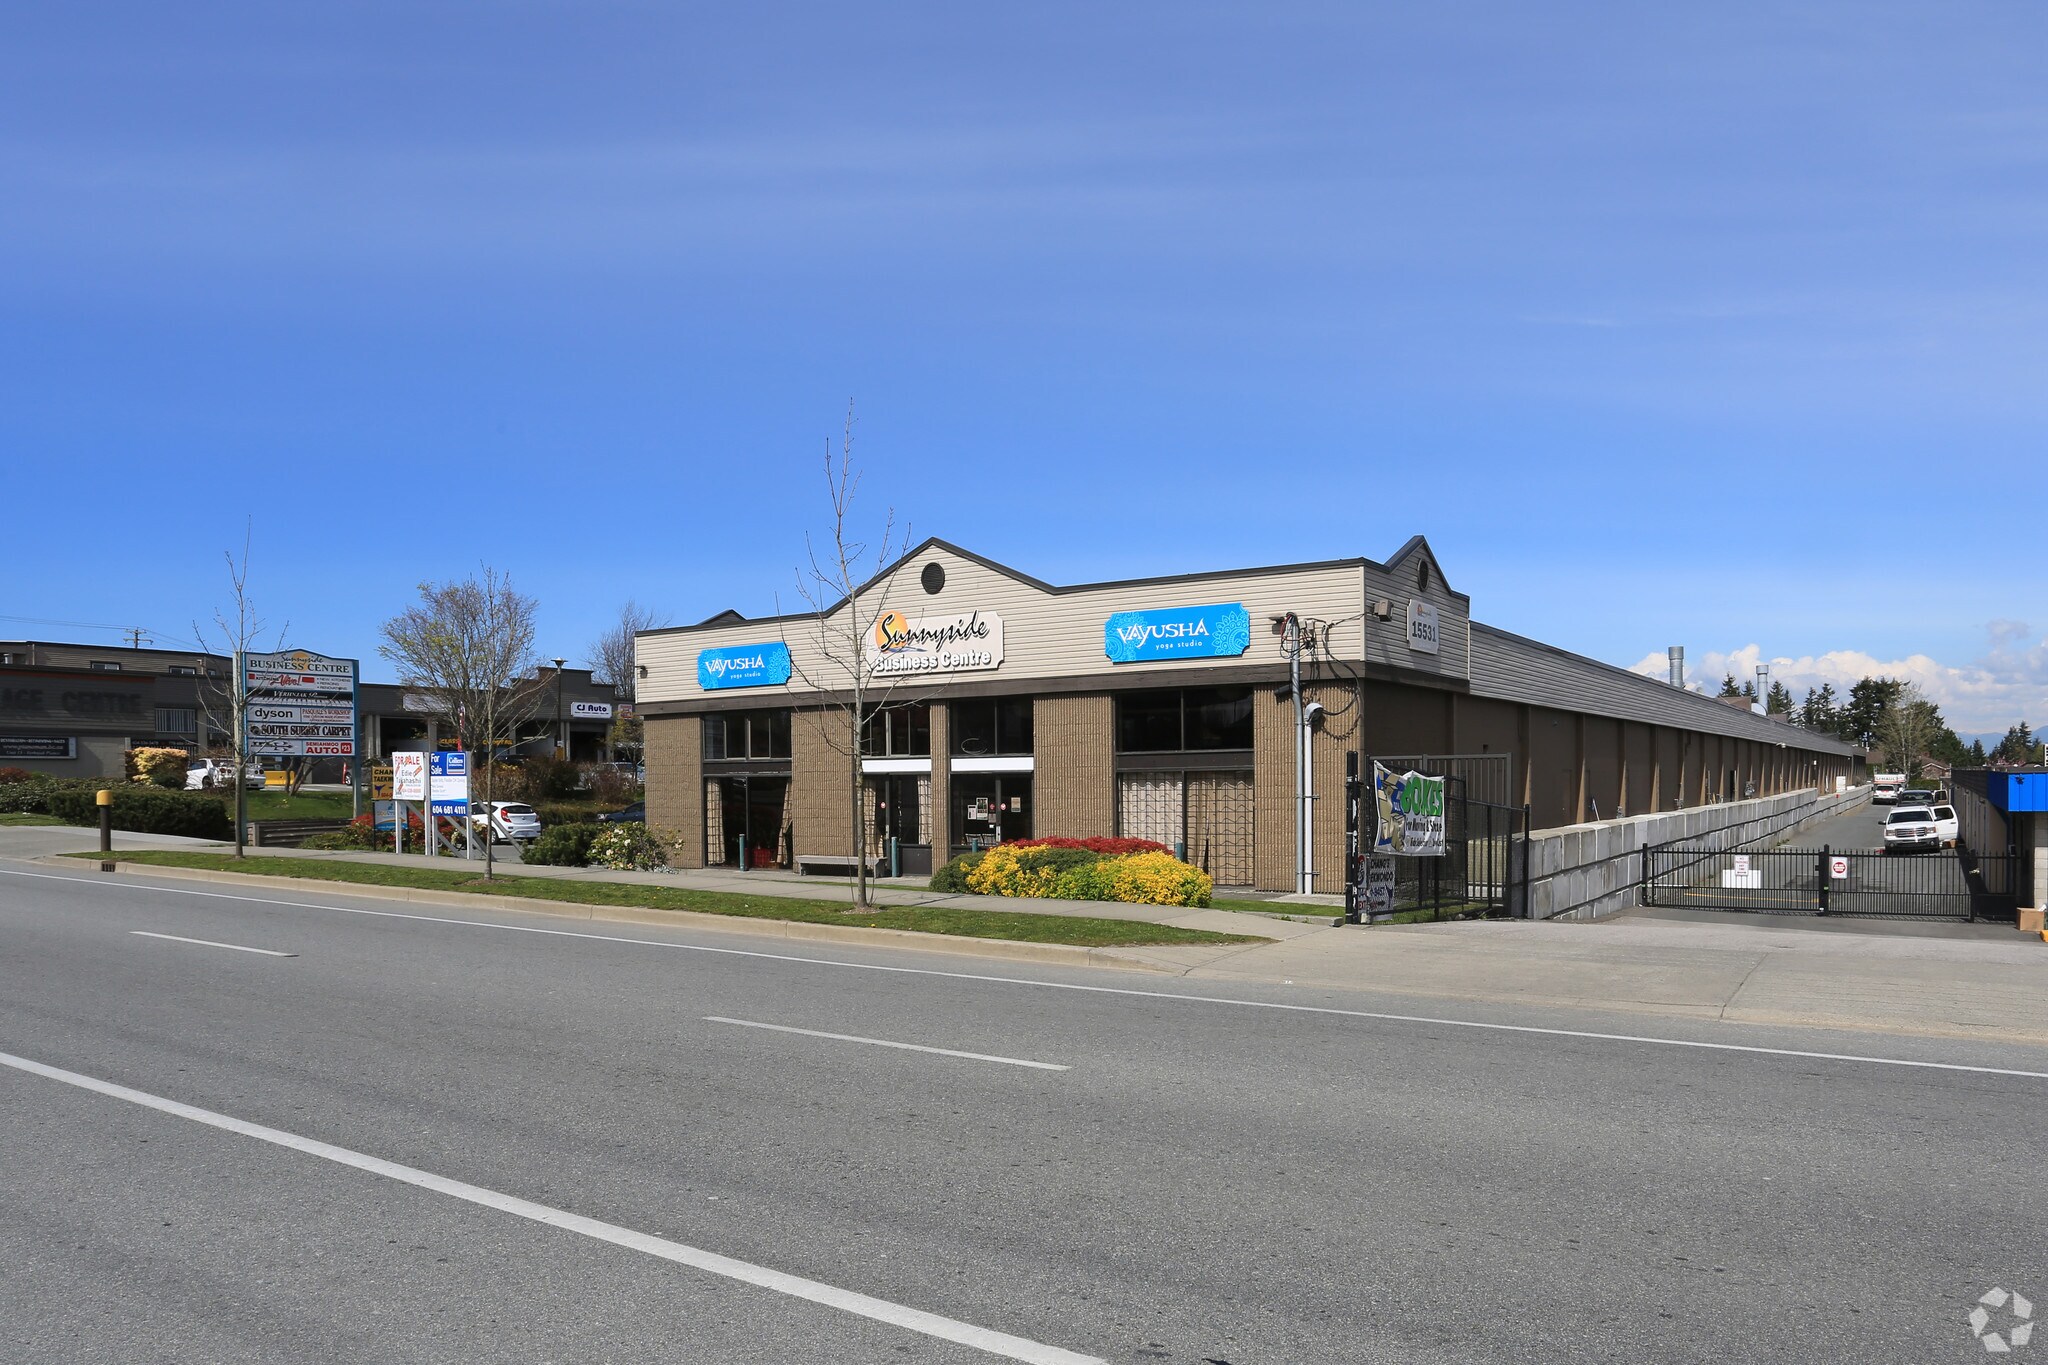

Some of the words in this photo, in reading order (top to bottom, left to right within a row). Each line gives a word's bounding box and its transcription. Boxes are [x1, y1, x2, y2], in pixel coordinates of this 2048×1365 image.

[881, 610, 990, 652] Sunnyside
[1117, 618, 1209, 648] VAYUSHA
[1412, 621, 1437, 643] 15531
[1178, 640, 1203, 648] studio
[281, 653, 324, 665] Sunnyside
[876, 654, 938, 672] Business
[942, 649, 991, 667] Centre
[250, 660, 304, 670] BUSINESS
[307, 663, 350, 673] CENTRE
[705, 654, 765, 678] VAYUSHA
[255, 707, 293, 720] dyson
[262, 725, 288, 735] SOUTH
[291, 726, 320, 736] SURREY
[322, 726, 352, 736] CARPET
[394, 756, 404, 765] FOR
[405, 756, 420, 765] ALE
[430, 753, 440, 763] For
[430, 766, 442, 774] Sale
[432, 805, 442, 814] 604
[444, 805, 454, 814] 681
[454, 805, 466, 814] 4111
